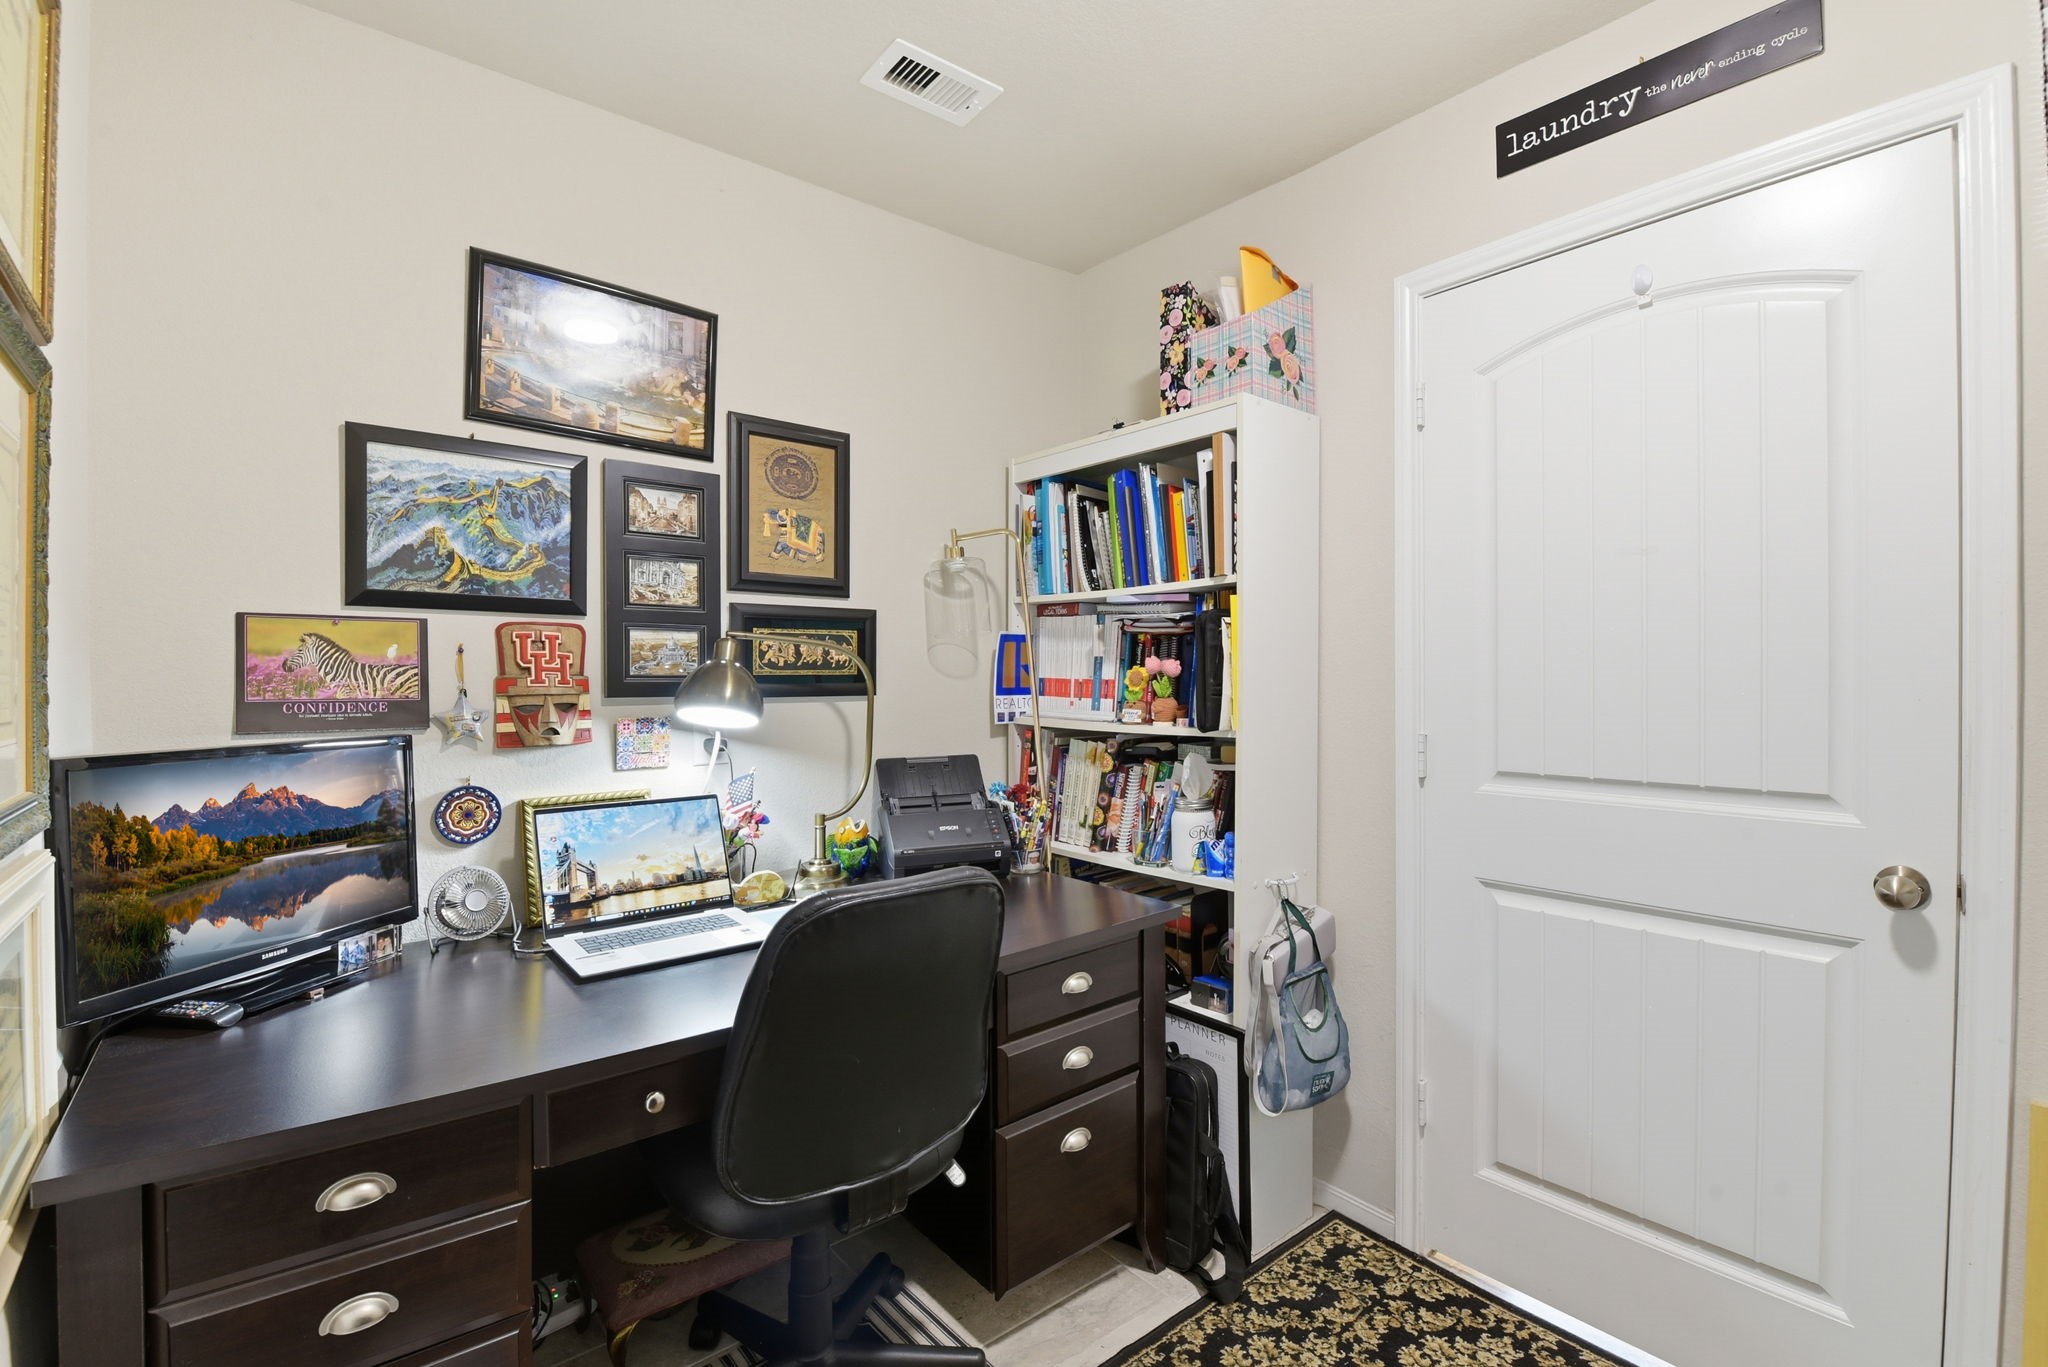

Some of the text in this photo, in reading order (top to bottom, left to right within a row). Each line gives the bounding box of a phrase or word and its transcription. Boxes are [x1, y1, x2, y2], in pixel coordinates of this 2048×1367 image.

[1506, 26, 1808, 157] laundry the never ending cycle
[282, 701, 388, 714] CONFIDENCE
[261, 947, 288, 960] SAMSUNG
[1170, 1015, 1226, 1046] PLANNER
[1205, 1049, 1226, 1062] NOTES
